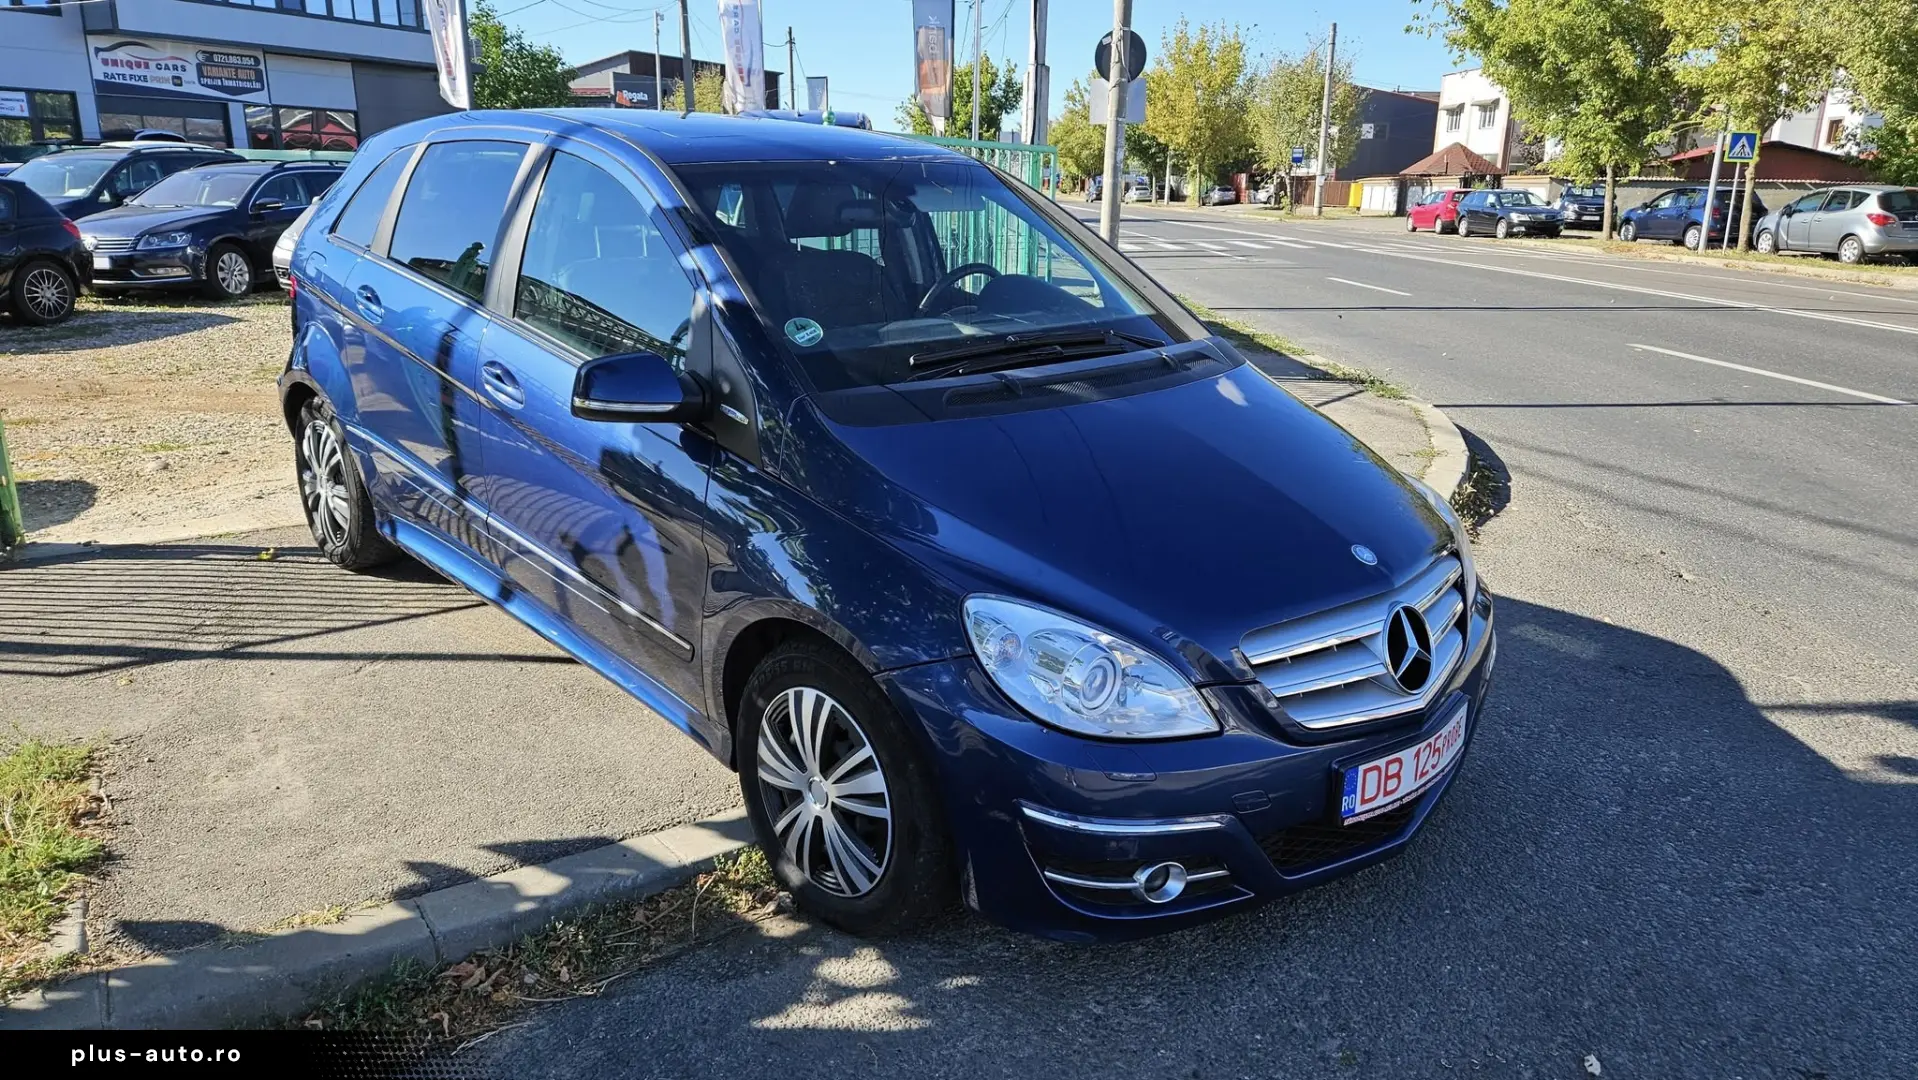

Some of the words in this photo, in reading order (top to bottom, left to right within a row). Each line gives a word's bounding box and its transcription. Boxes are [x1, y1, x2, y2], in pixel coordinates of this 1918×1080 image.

[101, 57, 150, 70] UNIQUE
[155, 62, 187, 72] CARS
[103, 72, 128, 82] RATE
[129, 73, 149, 83] FIXE
[201, 65, 237, 79] VARIANTE
[237, 69, 256, 80] AUTO
[622, 89, 649, 102] Regata
[1342, 794, 1356, 812] RO
[1360, 756, 1403, 806] DB
[1413, 732, 1443, 783] 125
